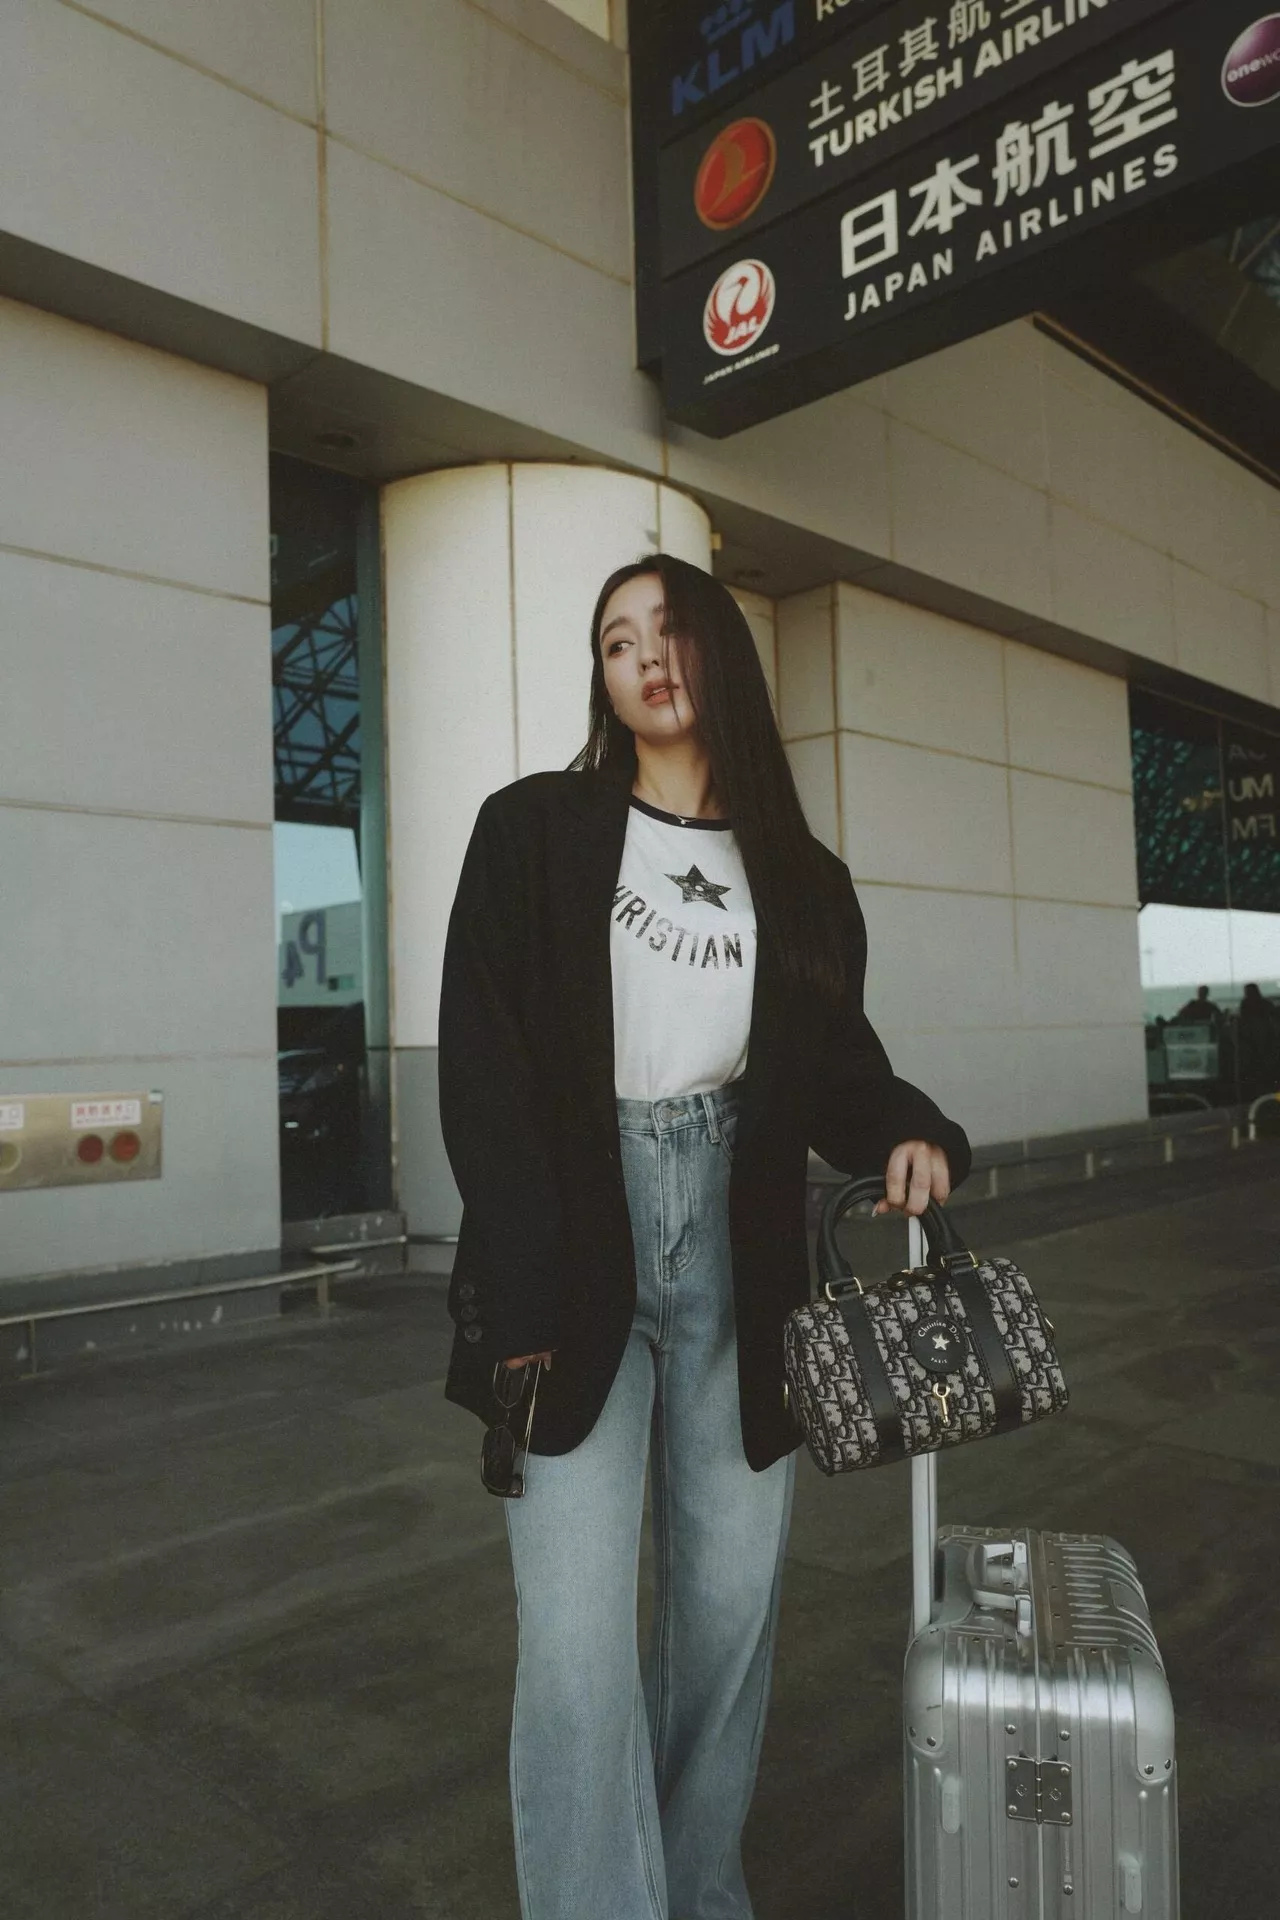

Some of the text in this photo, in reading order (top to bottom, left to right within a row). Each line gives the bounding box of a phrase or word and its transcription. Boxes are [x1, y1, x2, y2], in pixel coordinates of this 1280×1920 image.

[672, 0, 795, 117] KLM
[808, 0, 1036, 130] 土耳其航
[808, 57, 964, 168] TURKISH
[840, 49, 1178, 279] 日本航空
[844, 143, 1179, 322] JAPAN AIRLINES
[723, 316, 761, 345] JAL
